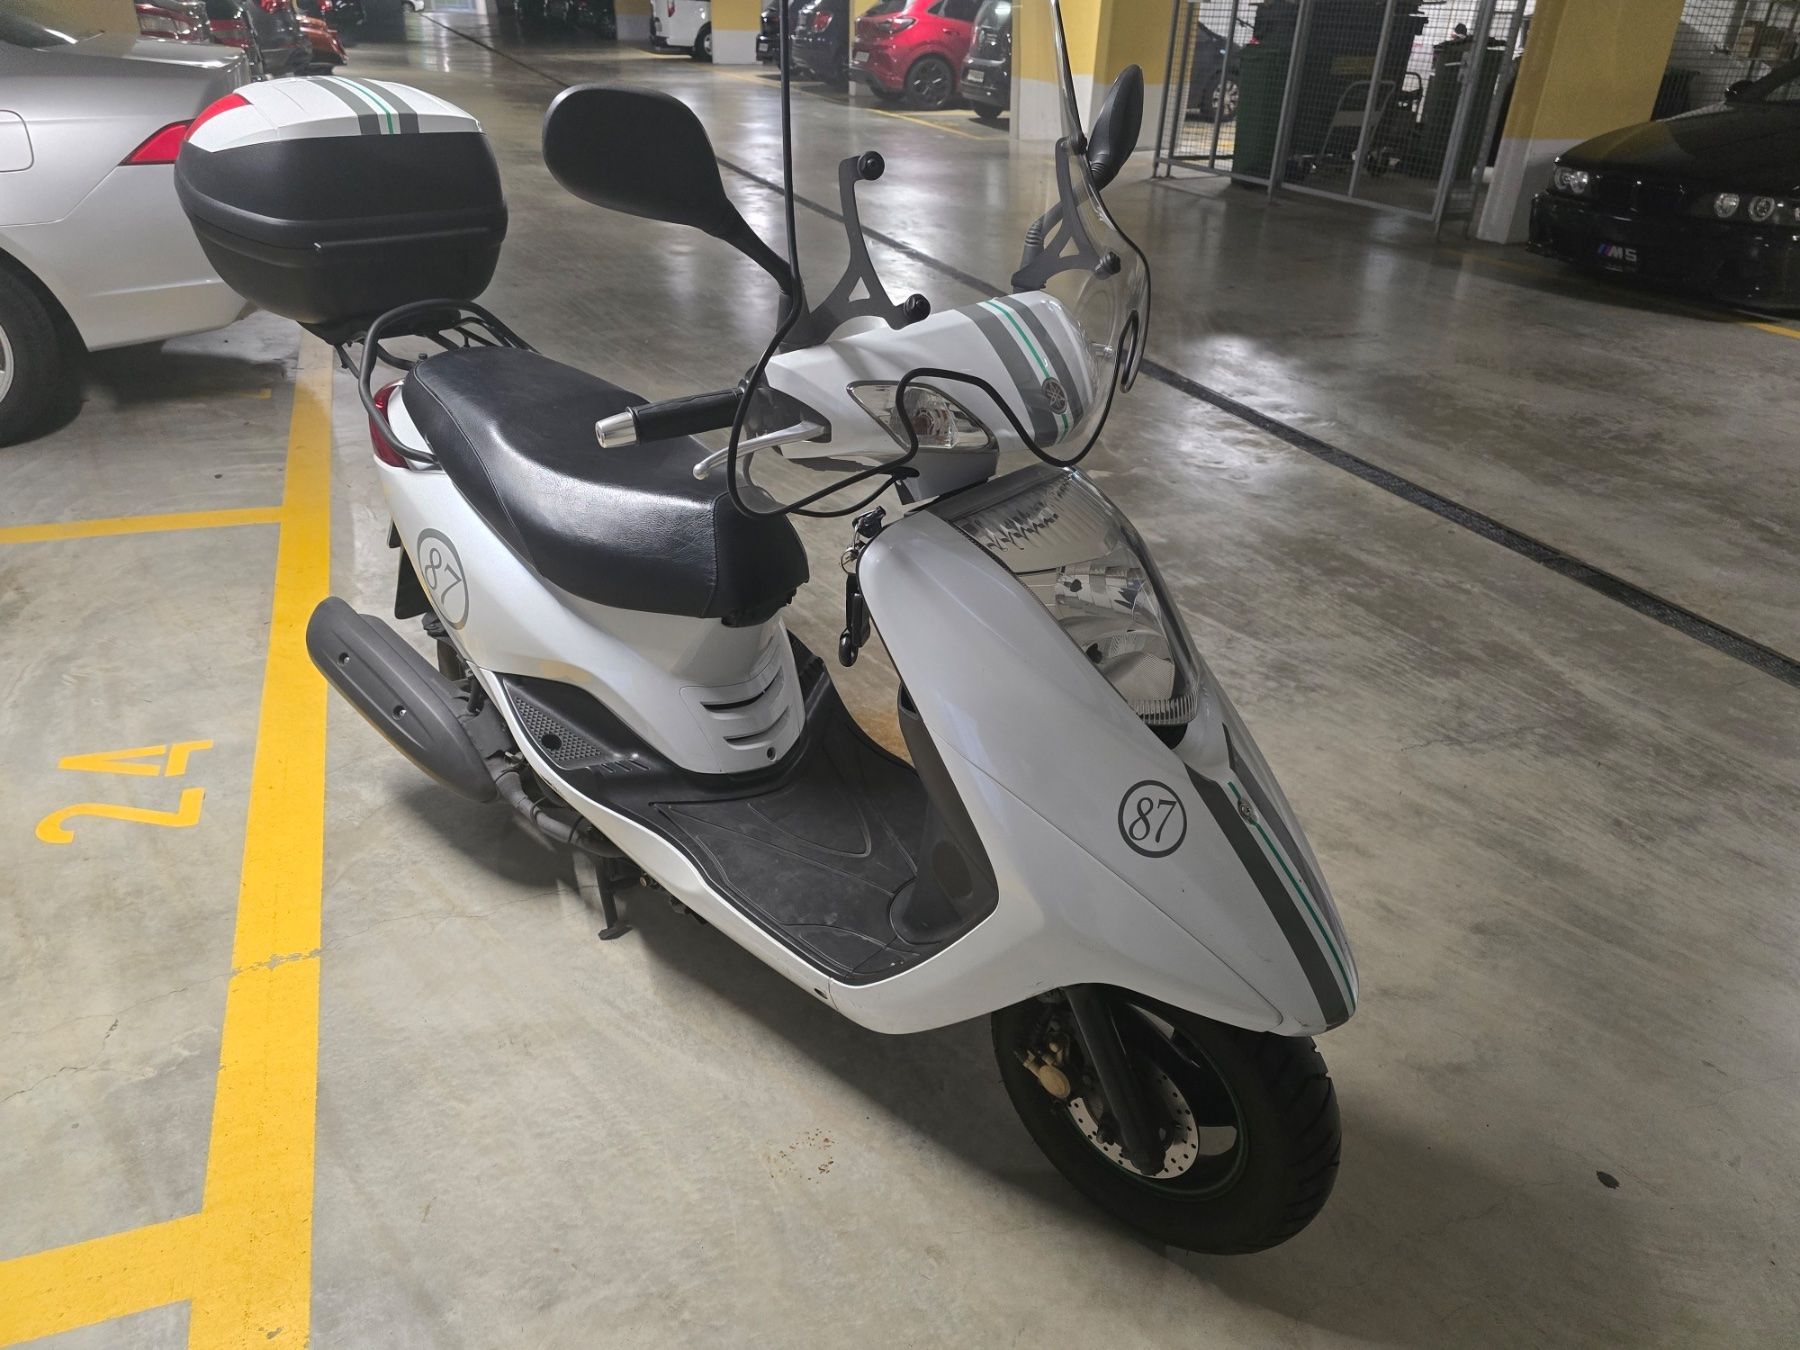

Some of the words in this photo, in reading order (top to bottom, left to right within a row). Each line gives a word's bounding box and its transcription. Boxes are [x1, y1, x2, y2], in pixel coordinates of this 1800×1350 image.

[1604, 245, 1637, 262] M5
[425, 547, 462, 605] 87
[35, 739, 213, 844] 24
[1128, 797, 1177, 843] 87
